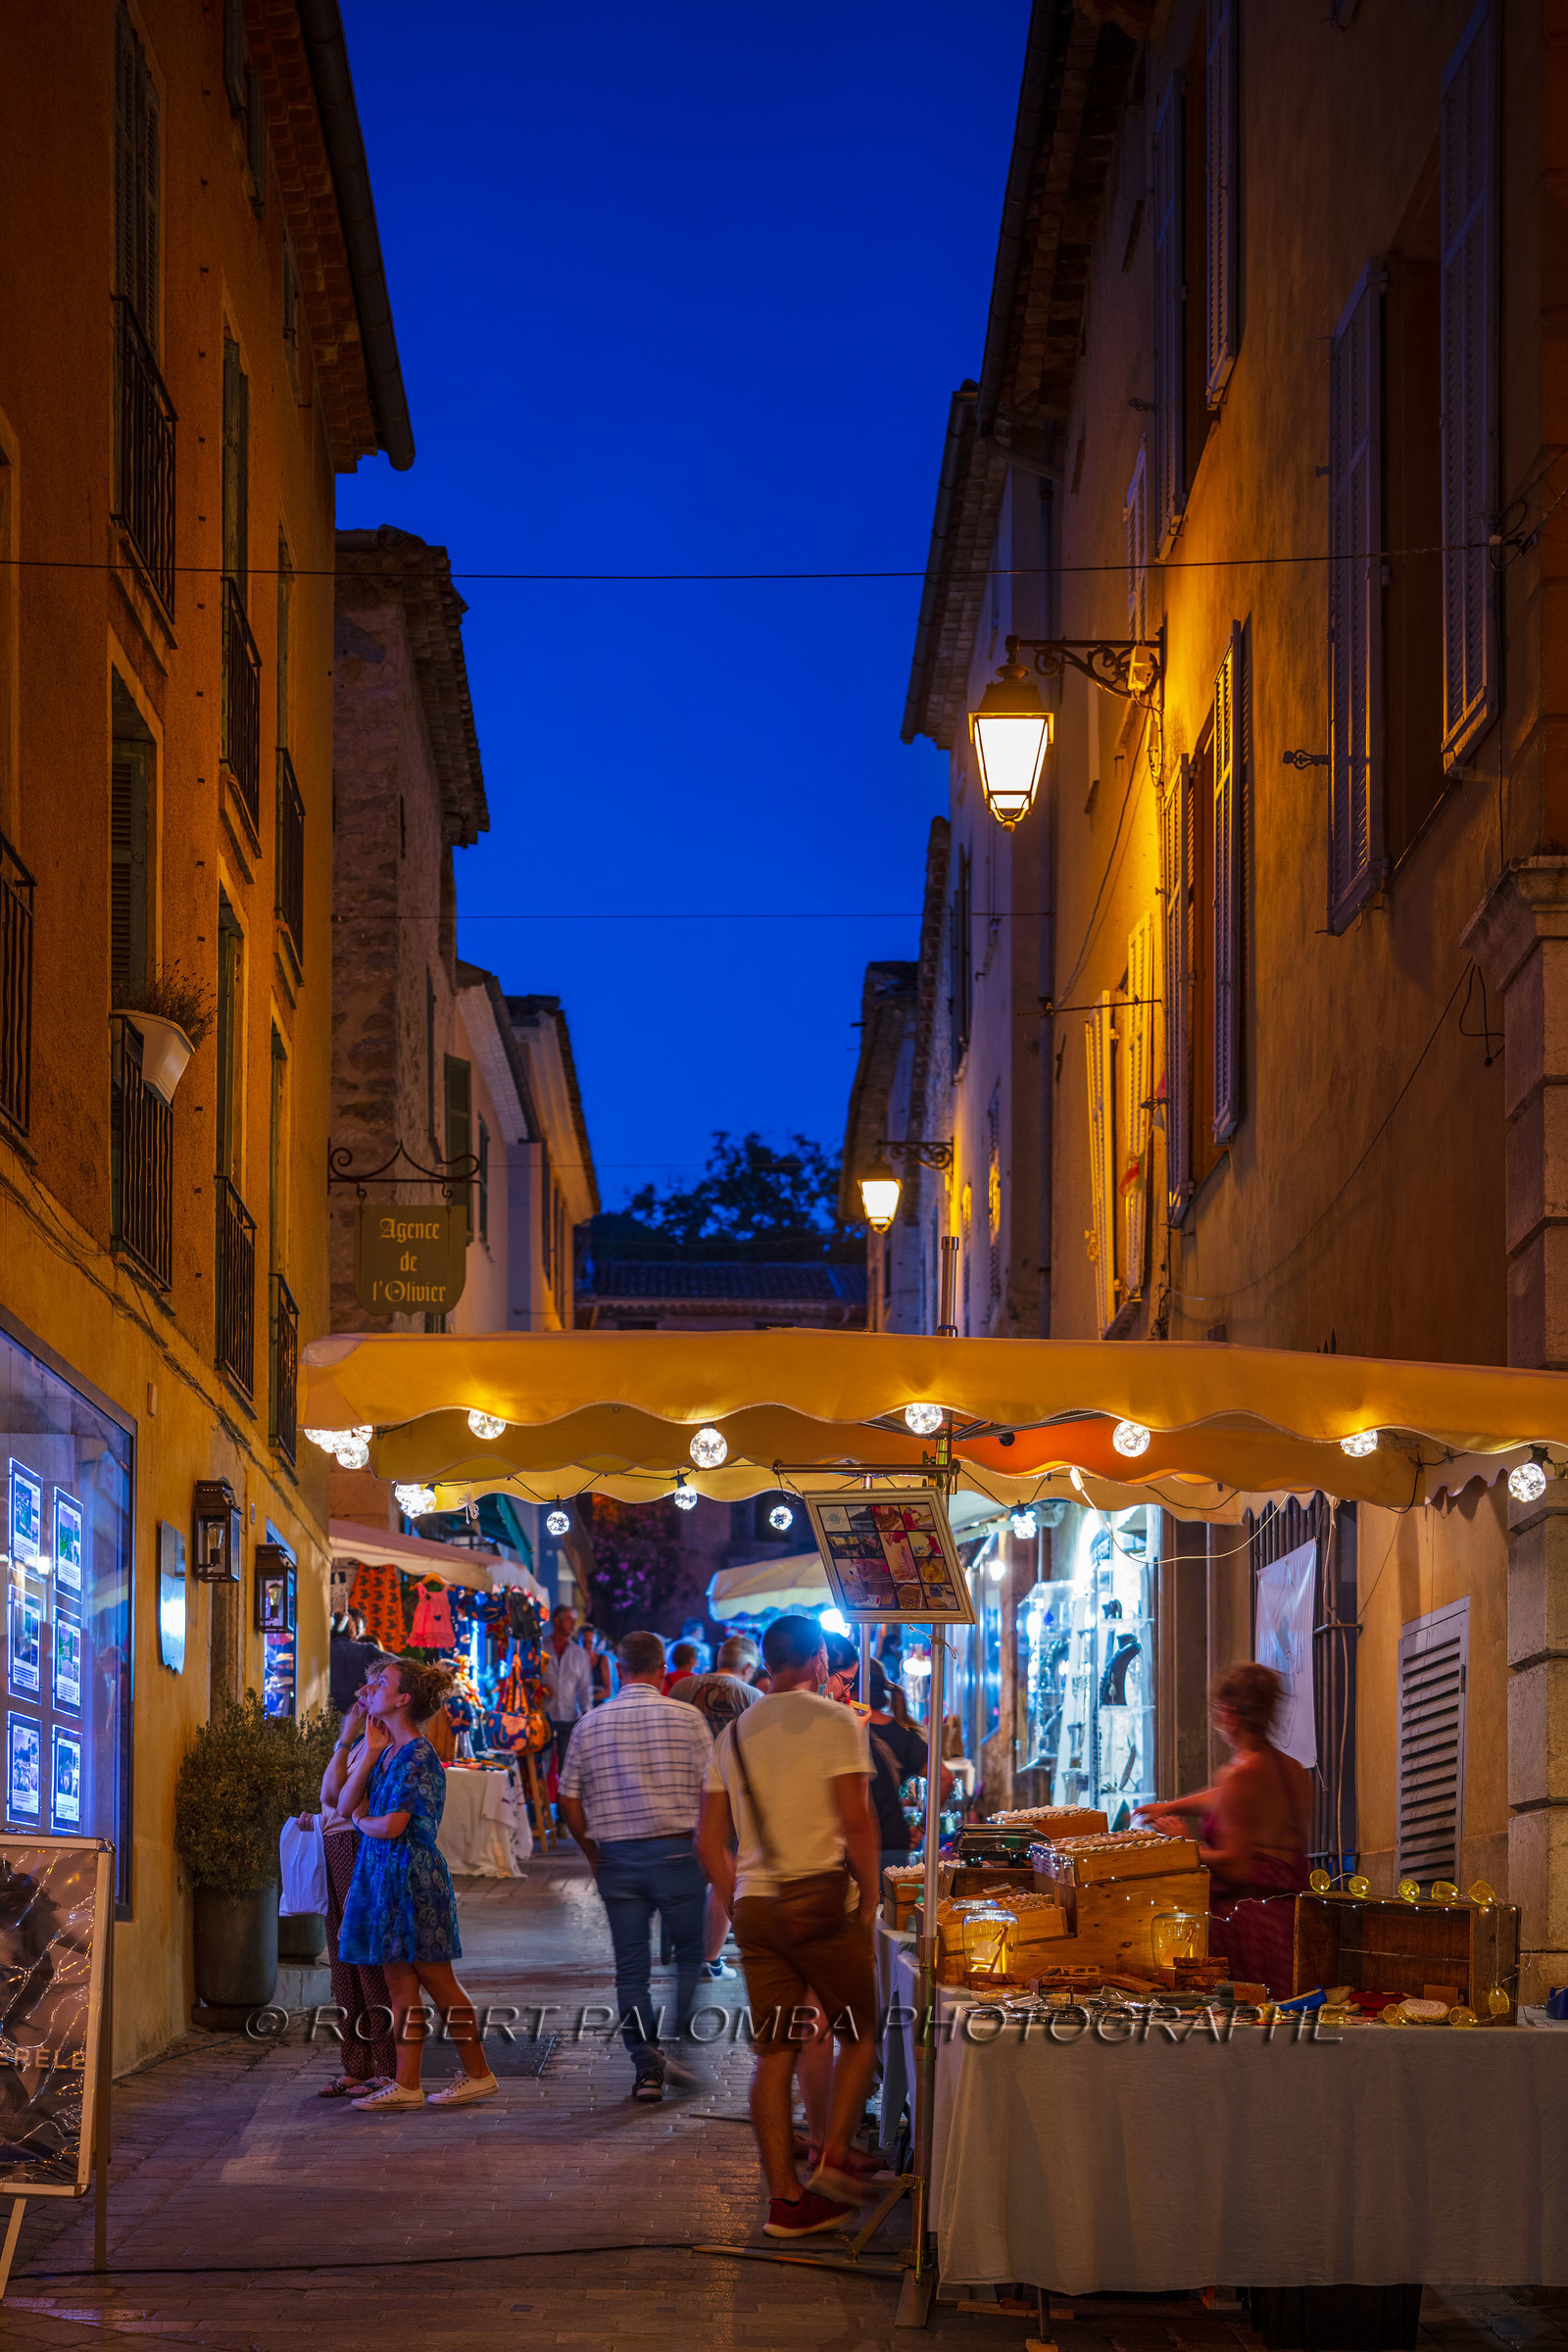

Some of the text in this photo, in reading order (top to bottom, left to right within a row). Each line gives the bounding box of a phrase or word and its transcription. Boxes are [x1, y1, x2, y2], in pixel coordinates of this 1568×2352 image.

[379, 1218, 440, 1244] Agence
[400, 1250, 417, 1272] de
[372, 1280, 447, 1302] l'Olivier
